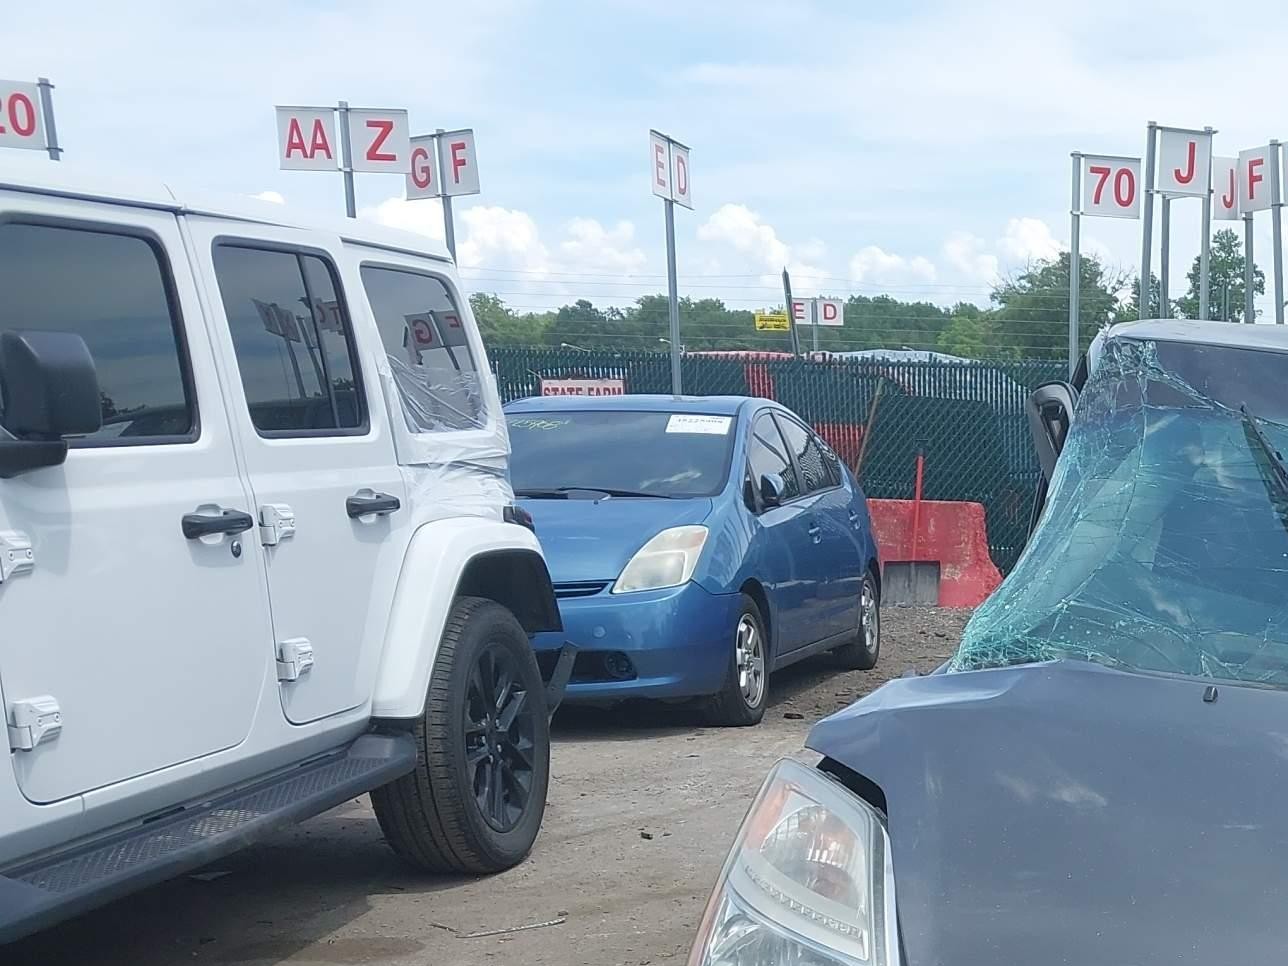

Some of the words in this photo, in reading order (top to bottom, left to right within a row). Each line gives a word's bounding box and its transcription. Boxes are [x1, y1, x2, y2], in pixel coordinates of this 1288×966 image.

[286, 117, 332, 159] AA
[366, 120, 397, 162] Z
[411, 147, 431, 189] G
[451, 142, 466, 184] F
[654, 144, 666, 188] E
[676, 155, 687, 195] D
[1174, 141, 1196, 185] J
[1248, 158, 1264, 200] F
[1091, 166, 1135, 208] 70
[1222, 168, 1235, 209] J
[793, 302, 805, 320] E
[823, 303, 837, 321] D
